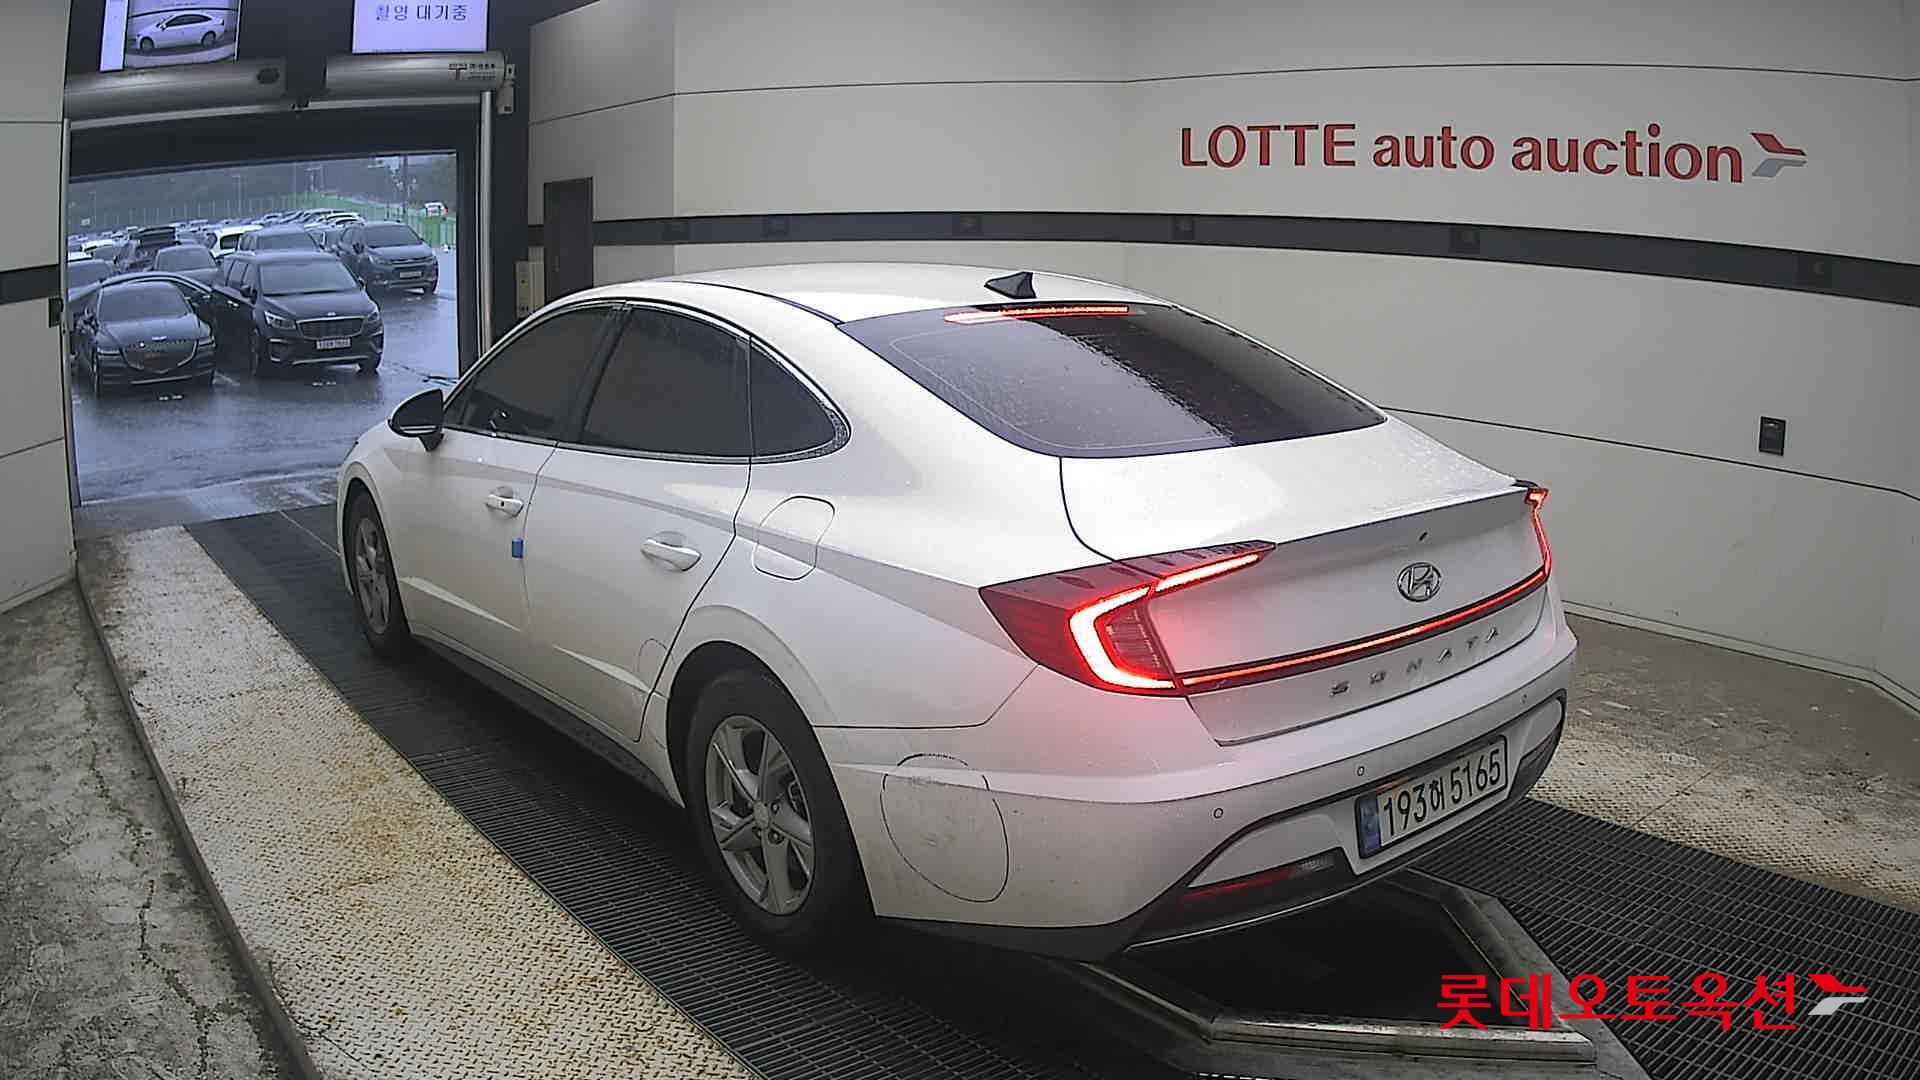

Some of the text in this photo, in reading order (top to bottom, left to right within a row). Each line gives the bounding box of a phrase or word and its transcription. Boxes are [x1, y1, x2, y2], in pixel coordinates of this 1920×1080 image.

[416, 4, 468, 21] 대기중
[1180, 123, 1744, 183] LOTTE auto auction
[1329, 627, 1499, 697] SONATA
